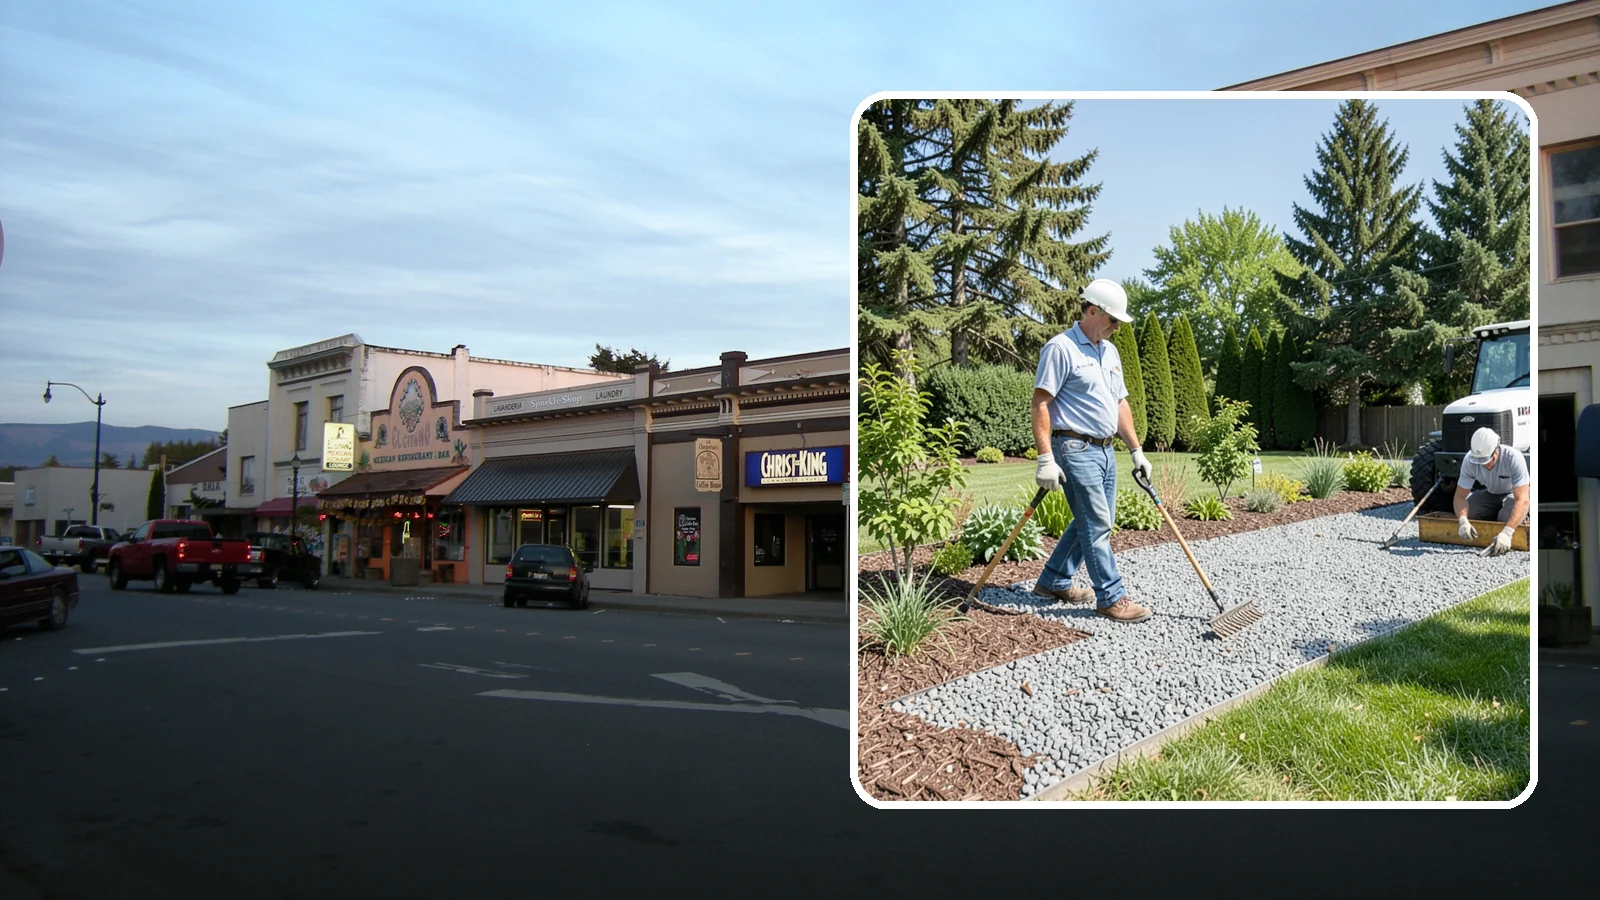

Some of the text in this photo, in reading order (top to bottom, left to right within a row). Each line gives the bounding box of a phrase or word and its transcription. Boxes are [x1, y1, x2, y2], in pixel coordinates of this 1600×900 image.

[595, 389, 624, 400] LAUNDRY
[493, 402, 522, 412] LAVANDERIA
[531, 394, 582, 409] Sparkle Shop
[373, 455, 396, 464] MEXICAN
[397, 451, 433, 462] RESTAURANT
[437, 450, 450, 458] BAR
[760, 450, 827, 478] CHRIST KING
[697, 481, 722, 489] Coffee House
